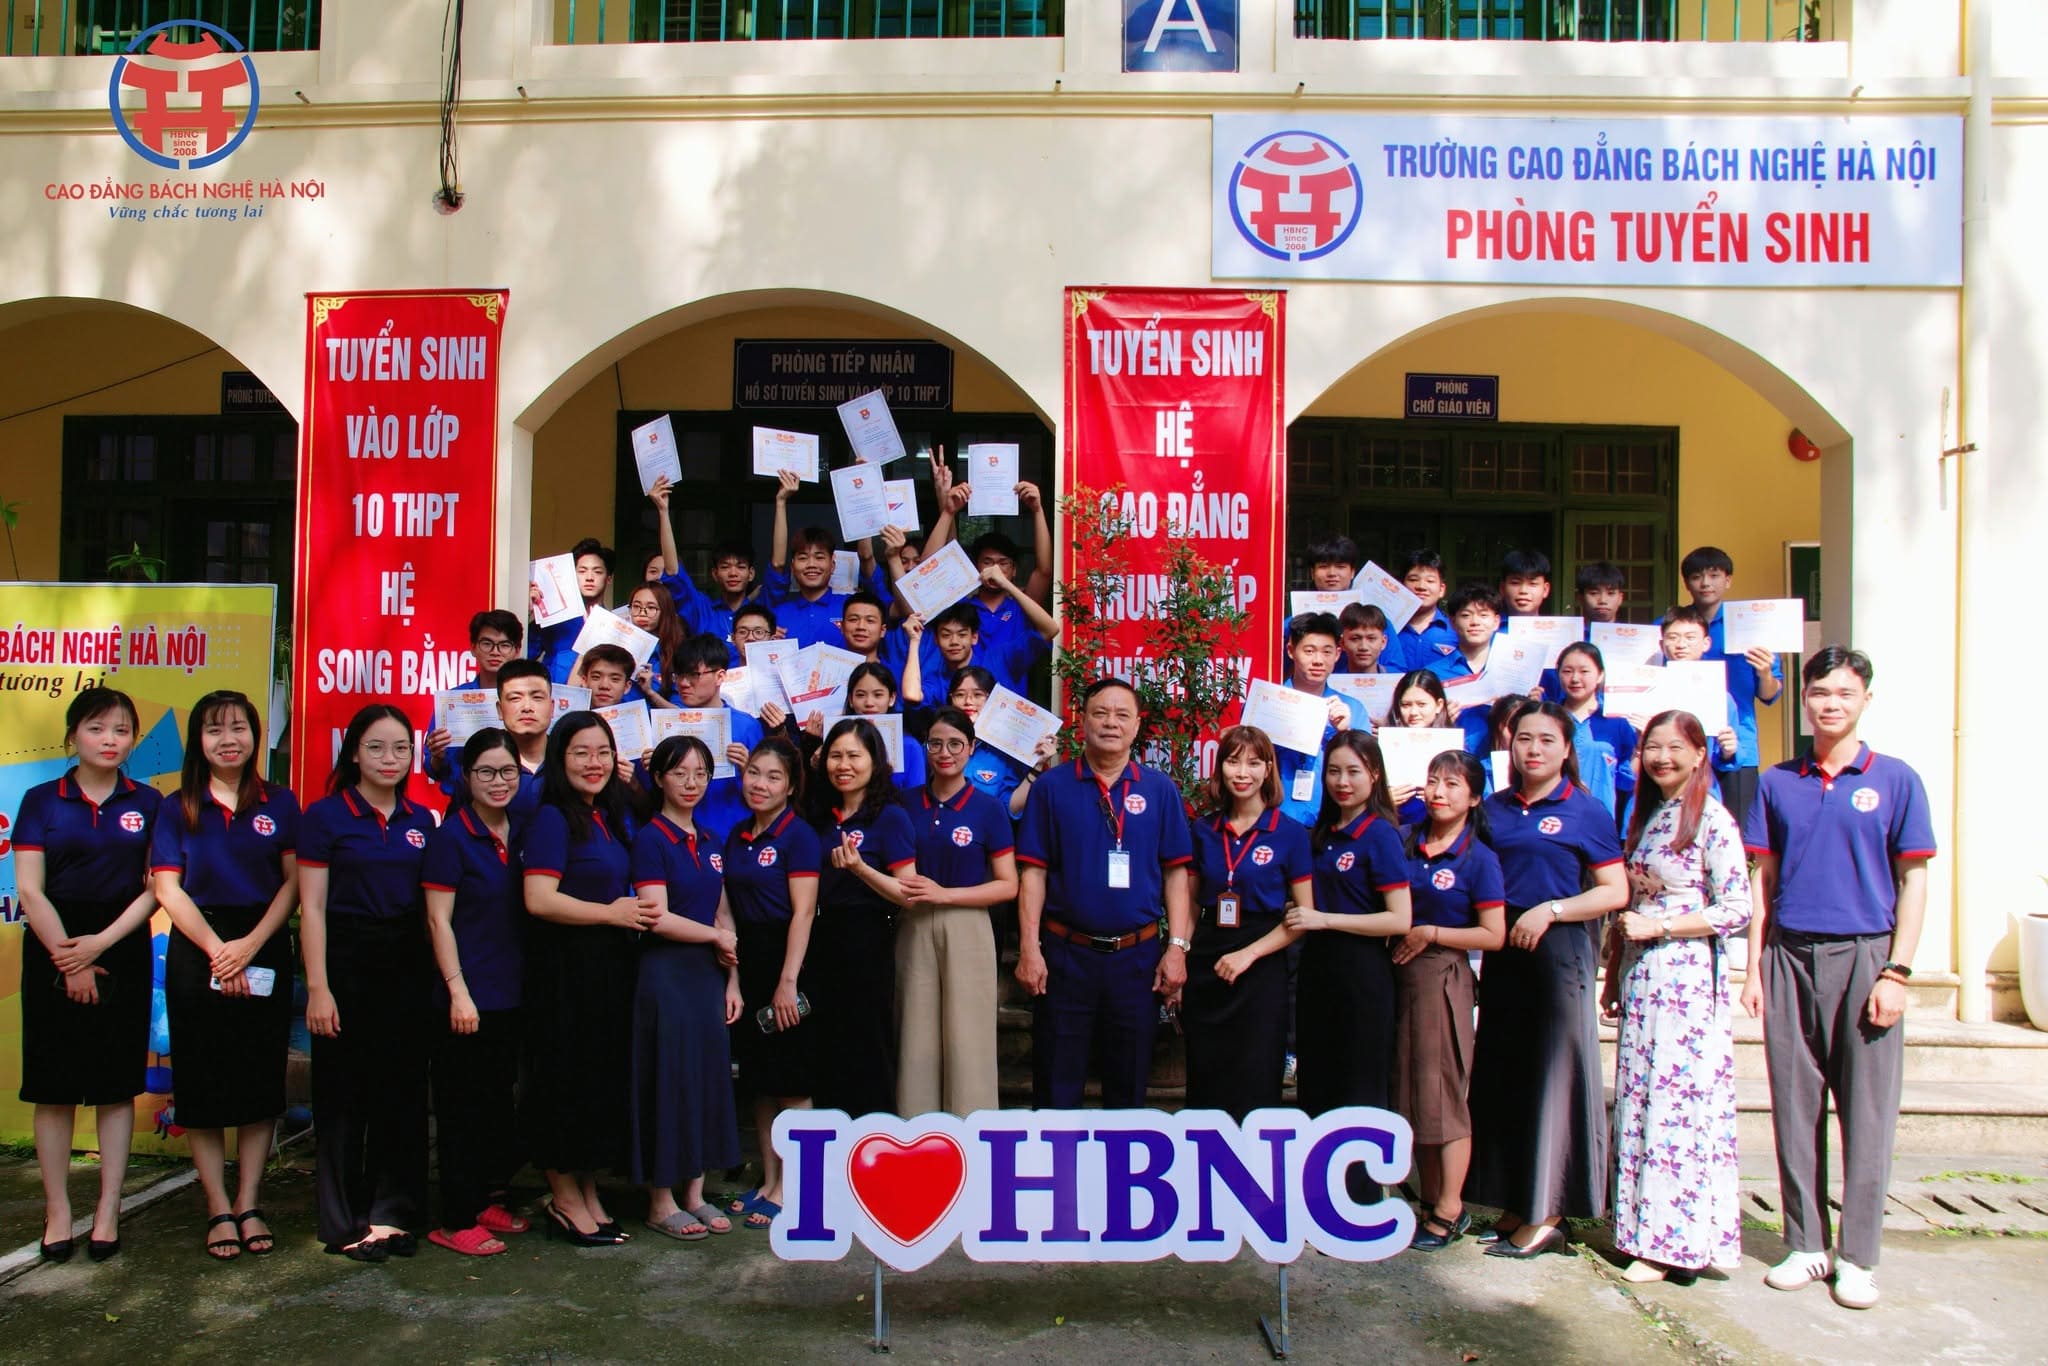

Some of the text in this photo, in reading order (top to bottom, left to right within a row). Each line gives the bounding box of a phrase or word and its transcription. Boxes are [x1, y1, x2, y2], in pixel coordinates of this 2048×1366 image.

[1143, 0, 1217, 52] A
[1383, 131, 1936, 188] TRƯỜNG CAO ĐẲNG BÁCH NGHỆ HÀ NỘI
[1447, 190, 1870, 263] PHÒNG TUYỂN SINH
[326, 319, 486, 382] TUYỂN SINH
[772, 347, 915, 378] PHÒNG TIẾP NHẬN
[1087, 312, 1263, 376] TUYỂN SINH
[763, 384, 778, 401] SƠ
[782, 379, 815, 401] TUYỂN
[819, 384, 845, 401] SINH
[898, 386, 910, 401] 10
[913, 386, 940, 402] THPT
[1435, 380, 1469, 394] PHÒNG
[1438, 398, 1462, 414] GIÁO
[1466, 398, 1491, 415] VIÊN
[346, 404, 459, 459] VÀO LỚP
[1156, 400, 1194, 468] HỆ
[353, 493, 459, 537] 10 THPT
[1100, 470, 1249, 540] CAO ĐẲNG
[381, 562, 415, 626] HỆ
[0, 624, 207, 674] BÁCH NGHỆ HÀ NỘI
[318, 633, 480, 694] SONG BẰNG
[0, 671, 64, 698] tương
[787, 1126, 1399, 1244] I HBNC
